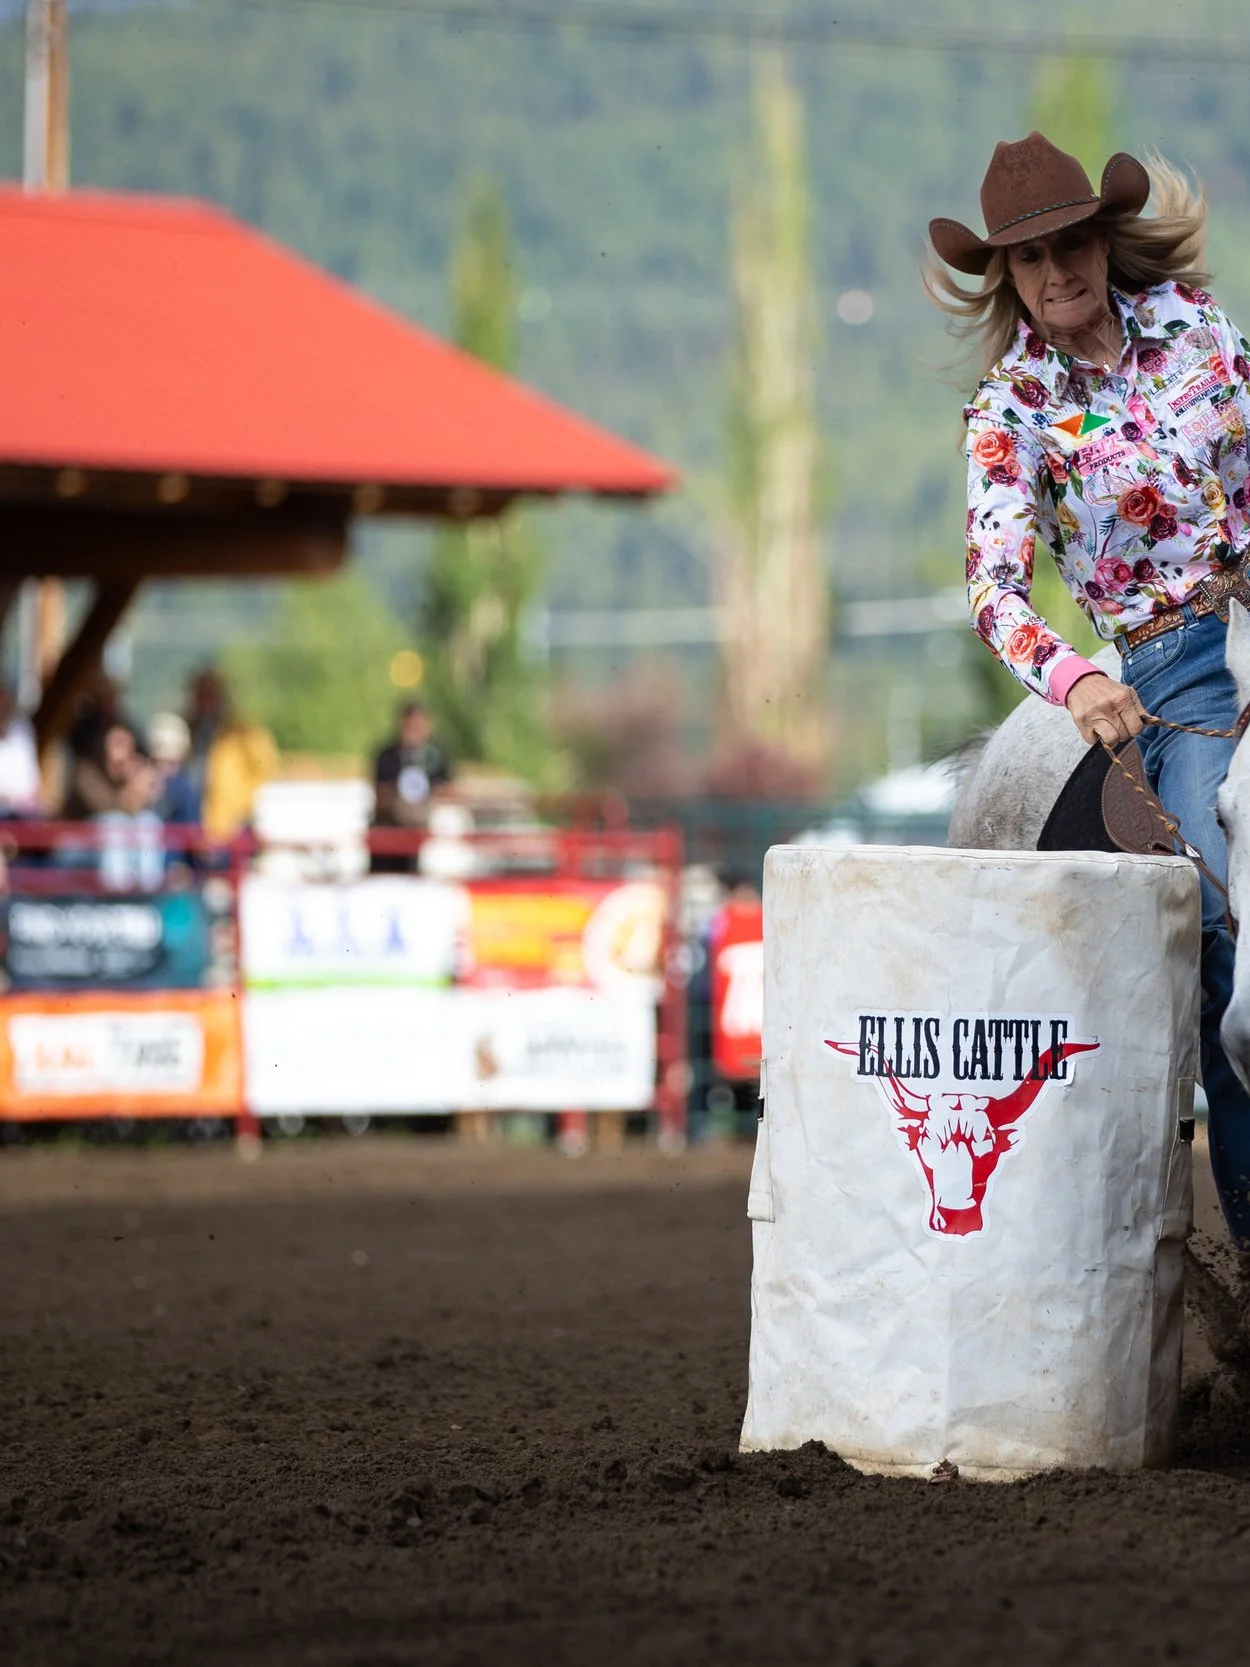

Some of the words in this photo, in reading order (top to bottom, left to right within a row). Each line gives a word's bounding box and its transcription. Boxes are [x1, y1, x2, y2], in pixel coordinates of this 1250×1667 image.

[1089, 450, 1126, 471] PRODUCTS
[856, 1015, 941, 1079] ELLIS
[952, 1018, 1069, 1081] CATTLE
